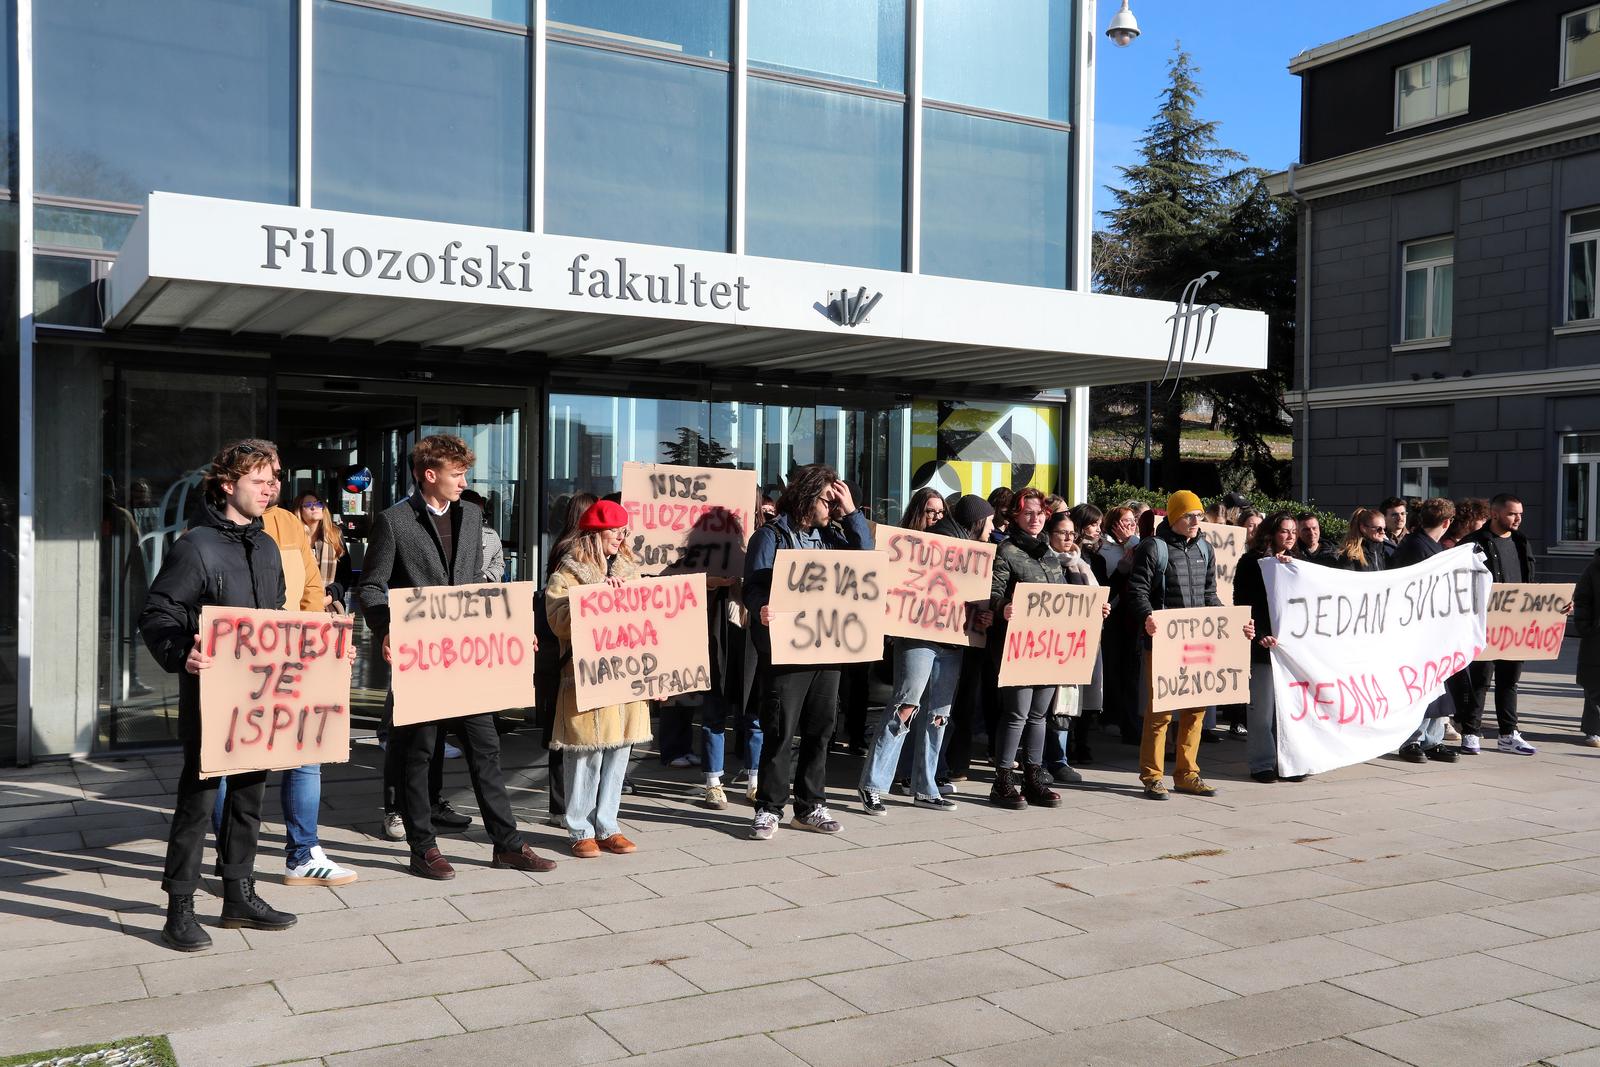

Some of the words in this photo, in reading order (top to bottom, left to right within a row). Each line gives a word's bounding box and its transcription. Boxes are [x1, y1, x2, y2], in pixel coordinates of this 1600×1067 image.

[260, 224, 533, 292] Filozofski
[568, 253, 751, 311] fakultet
[649, 473, 712, 502] NIJE
[623, 501, 748, 539] FILOZOFSKI
[889, 534, 991, 578] STUDENTI
[580, 581, 698, 619] KORUPCIJA
[787, 561, 828, 593] UZ
[834, 562, 880, 601] VAS
[904, 568, 958, 597] ZA
[404, 587, 512, 622] ŽIVJETI
[1026, 590, 1097, 618] PROTIV
[1287, 587, 1391, 638] JEDAN
[1400, 567, 1488, 627] SVIJET
[1486, 589, 1520, 613] NE
[1520, 593, 1566, 613] DAMO
[207, 617, 353, 662] PROTEST
[592, 619, 658, 652] VLADA
[790, 609, 868, 654] SMO
[1007, 629, 1087, 665] NASILJA
[1167, 615, 1230, 641] OTPOR
[398, 632, 525, 672] SLOBODNO
[579, 652, 658, 687] NAROD
[249, 661, 308, 701] JE
[630, 665, 711, 697] STRADA
[1157, 665, 1243, 700] DUŽNOST
[1288, 673, 1389, 726] JEDNA
[224, 703, 344, 753] ISPIT
